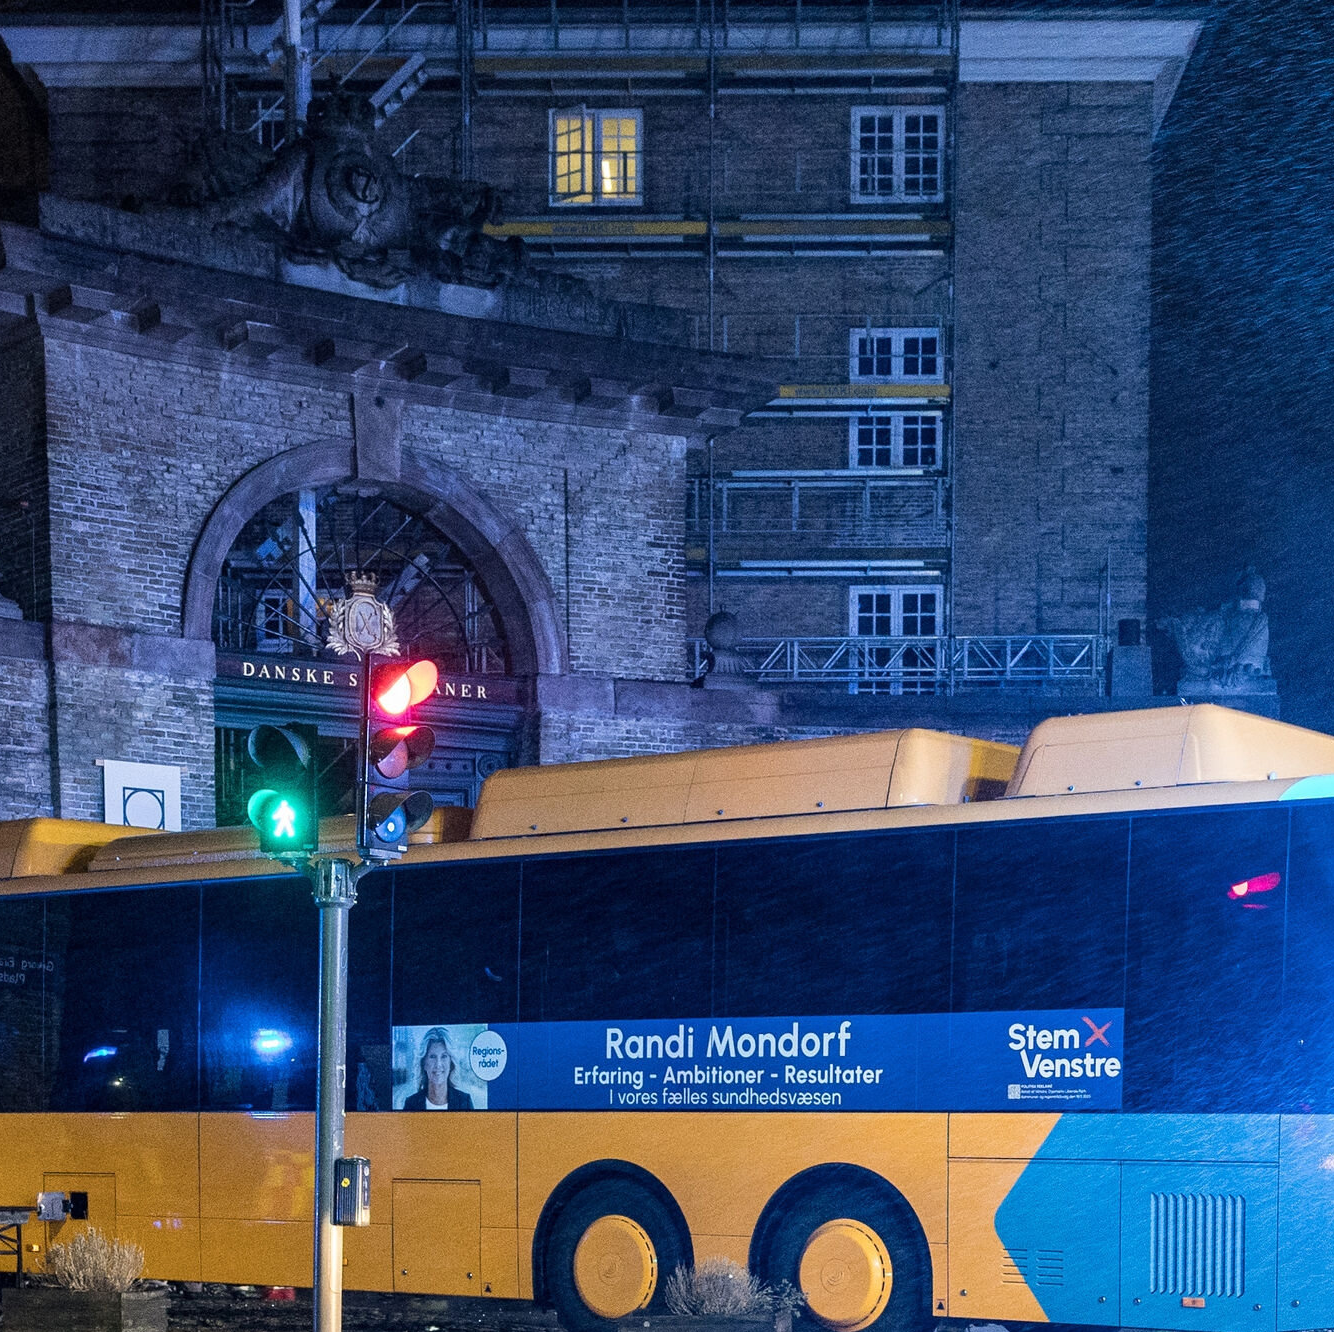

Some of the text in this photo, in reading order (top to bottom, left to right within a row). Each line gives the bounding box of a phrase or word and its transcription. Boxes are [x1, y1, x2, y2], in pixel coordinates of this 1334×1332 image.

[242, 661, 335, 684] DANSKE
[605, 1021, 852, 1059] Randi Mondorf
[1008, 1023, 1080, 1051] Stem
[472, 1046, 505, 1058] Regions-
[1020, 1049, 1121, 1078] Venstre
[574, 1065, 644, 1090] Erfaring
[663, 1065, 764, 1084] Ambitioner
[784, 1064, 883, 1084] Resultater
[618, 1091, 658, 1105] vores
[662, 1088, 708, 1105] fælles
[712, 1088, 842, 1106] sundhedsvæsen
